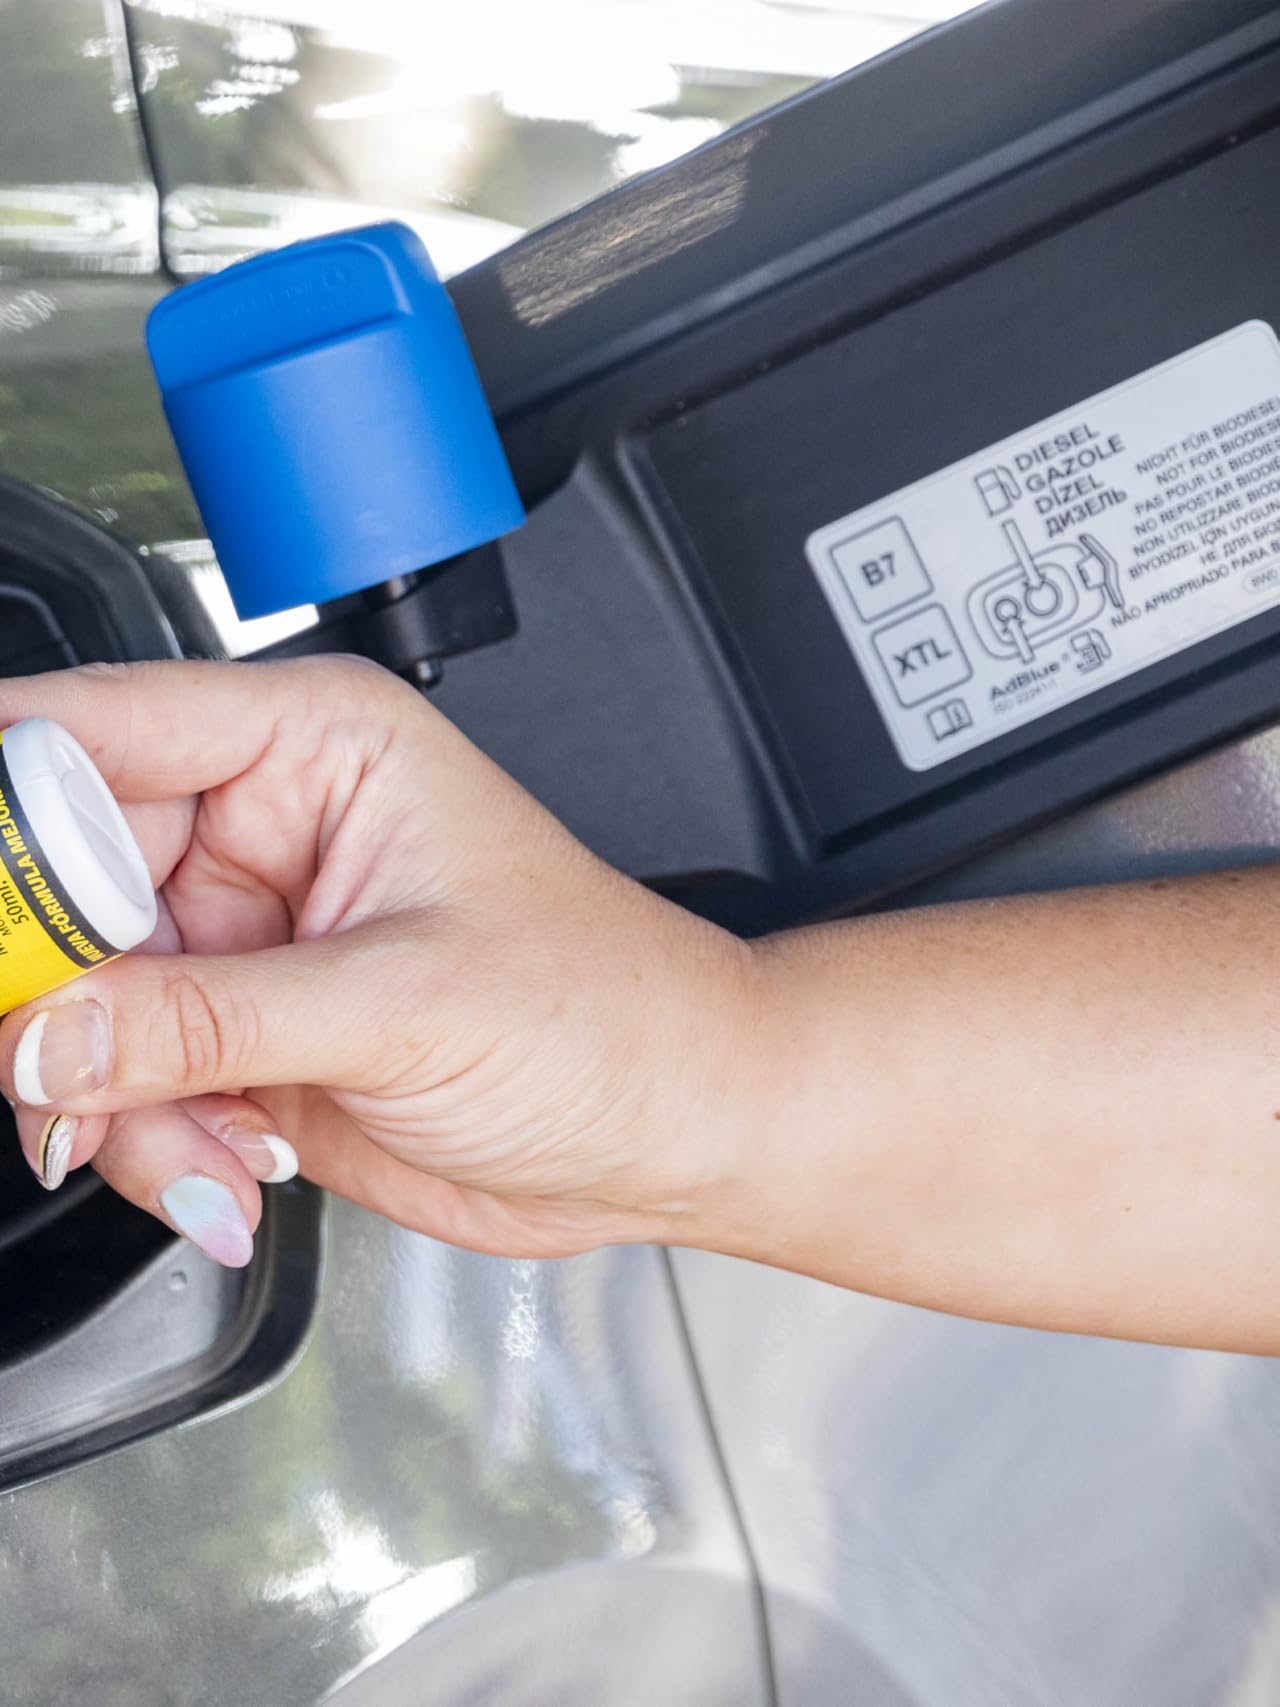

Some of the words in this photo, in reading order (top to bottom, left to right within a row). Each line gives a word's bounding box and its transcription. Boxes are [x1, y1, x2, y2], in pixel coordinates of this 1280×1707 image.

[1013, 423, 1100, 472] DIESEL
[1025, 433, 1126, 493] GAZOLE
[1136, 447, 1179, 475] NICHT
[1155, 464, 1186, 486] NOT
[1189, 448, 1222, 471] FOR
[1044, 487, 1128, 538] ДИЗЕЛЬ
[1134, 495, 1164, 515] PAS
[1166, 474, 1207, 501] POUR
[1209, 463, 1225, 483] LE
[1134, 515, 1158, 536] NO
[1160, 482, 1233, 524] REPOSTAR
[1132, 536, 1166, 557] NON
[1169, 498, 1242, 541] UTILIZZARE
[861, 552, 896, 587] B7
[1144, 567, 1230, 614] APROPRIADO
[1231, 548, 1269, 572] PARA
[893, 637, 952, 677] XTL
[990, 662, 1061, 699] AdBlue
[16, 853, 75, 936] FÓRMULA
[66, 930, 106, 962] NUEVA
